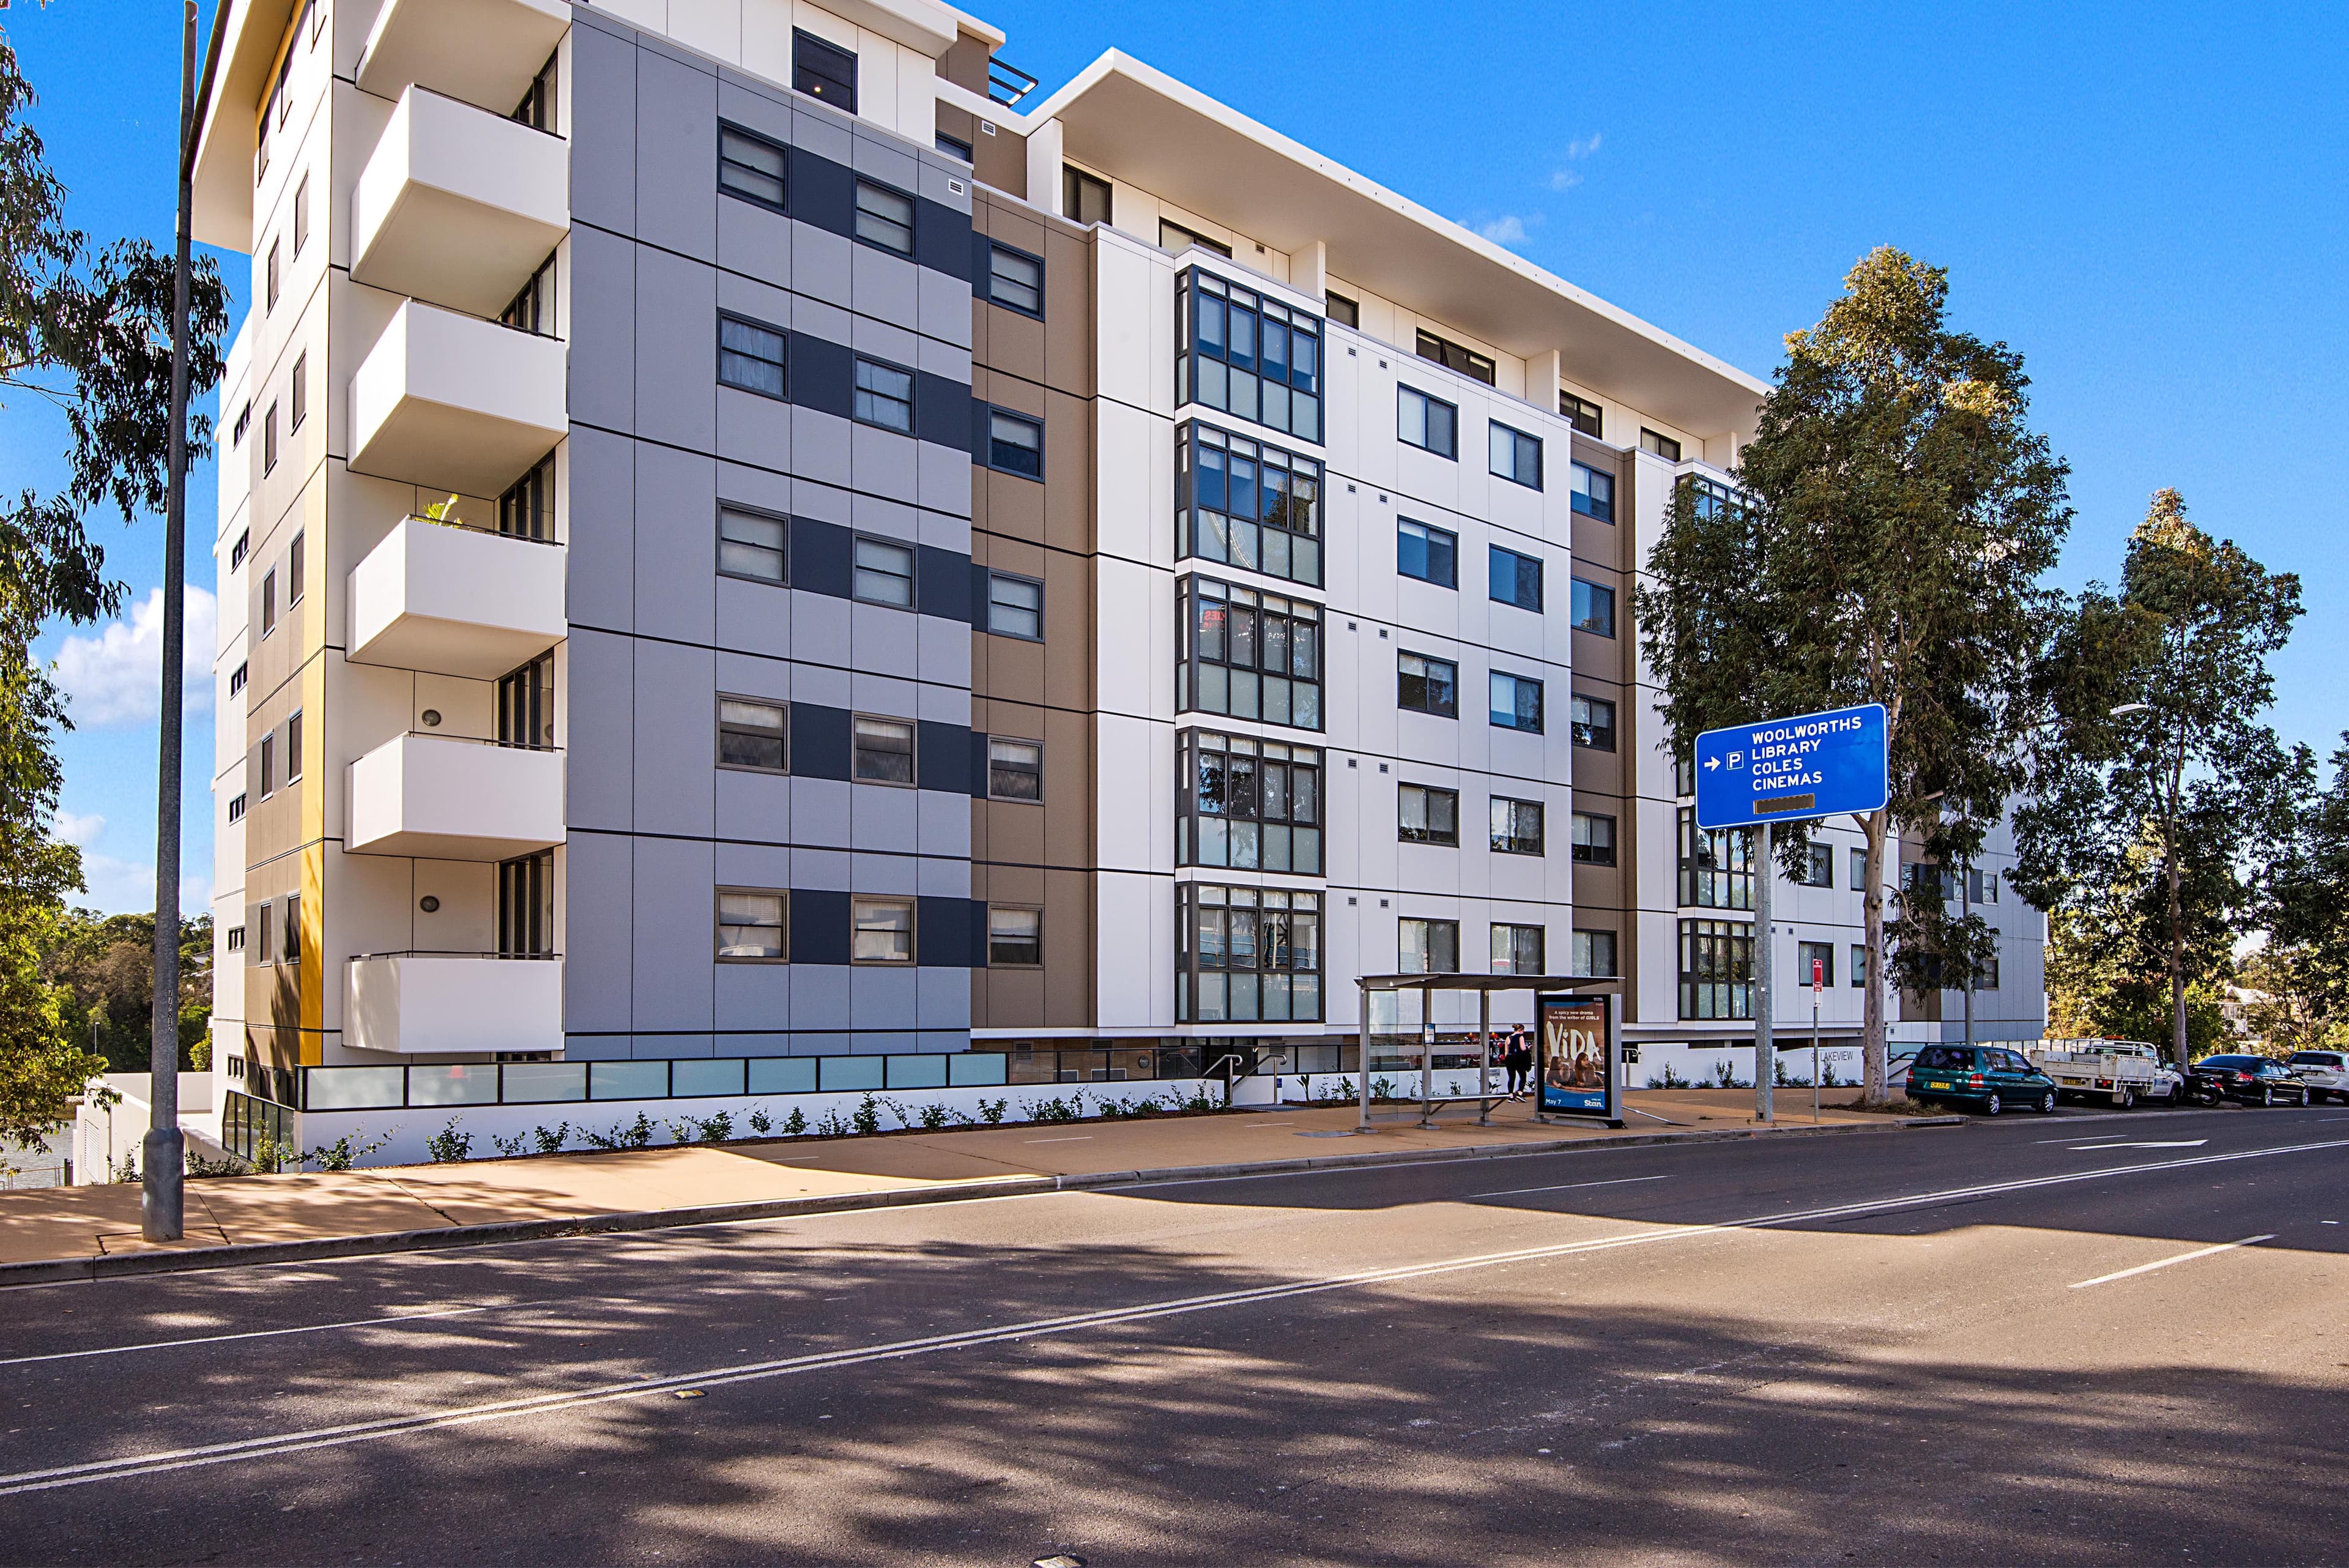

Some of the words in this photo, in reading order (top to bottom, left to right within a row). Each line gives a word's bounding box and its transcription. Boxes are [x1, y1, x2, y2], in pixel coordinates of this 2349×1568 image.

[1752, 716, 1862, 745] WOOLWORTHS
[1752, 738, 1822, 760] LIBRARY
[1729, 753, 1741, 768] P
[1752, 757, 1803, 776] COLES
[1753, 771, 1823, 791] CINEMAS
[1820, 1051, 1854, 1061] LAKEVIEW
